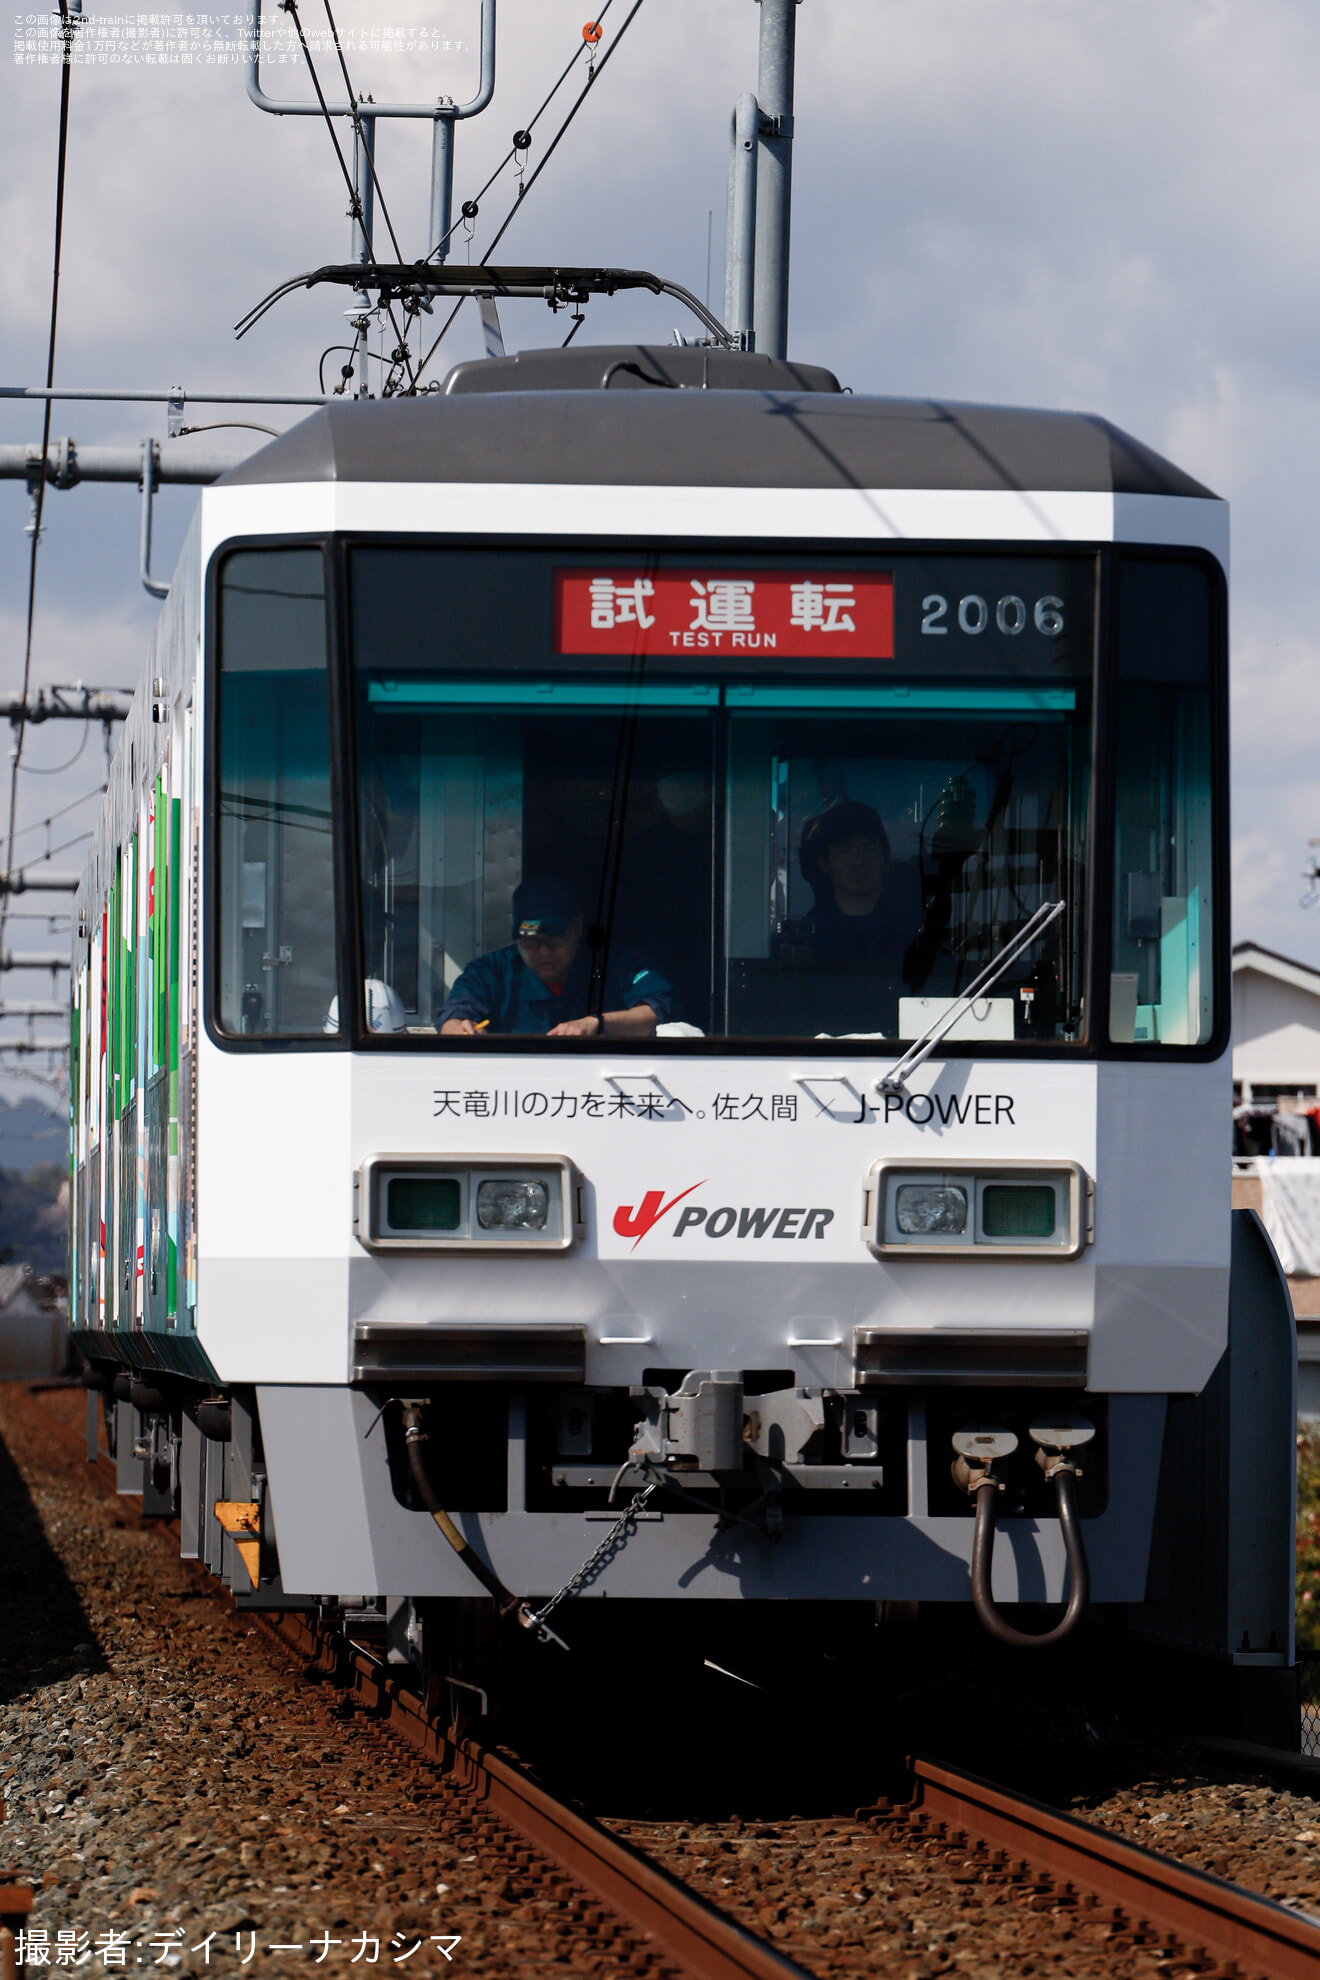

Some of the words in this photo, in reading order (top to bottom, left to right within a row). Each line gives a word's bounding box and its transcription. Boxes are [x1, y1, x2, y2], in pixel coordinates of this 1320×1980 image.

[588, 577, 857, 633] 試運転
[920, 593, 1066, 636] 2006
[669, 631, 724, 648] TEST
[732, 632, 777, 649] RUN
[852, 1093, 1017, 1126] J-POWER
